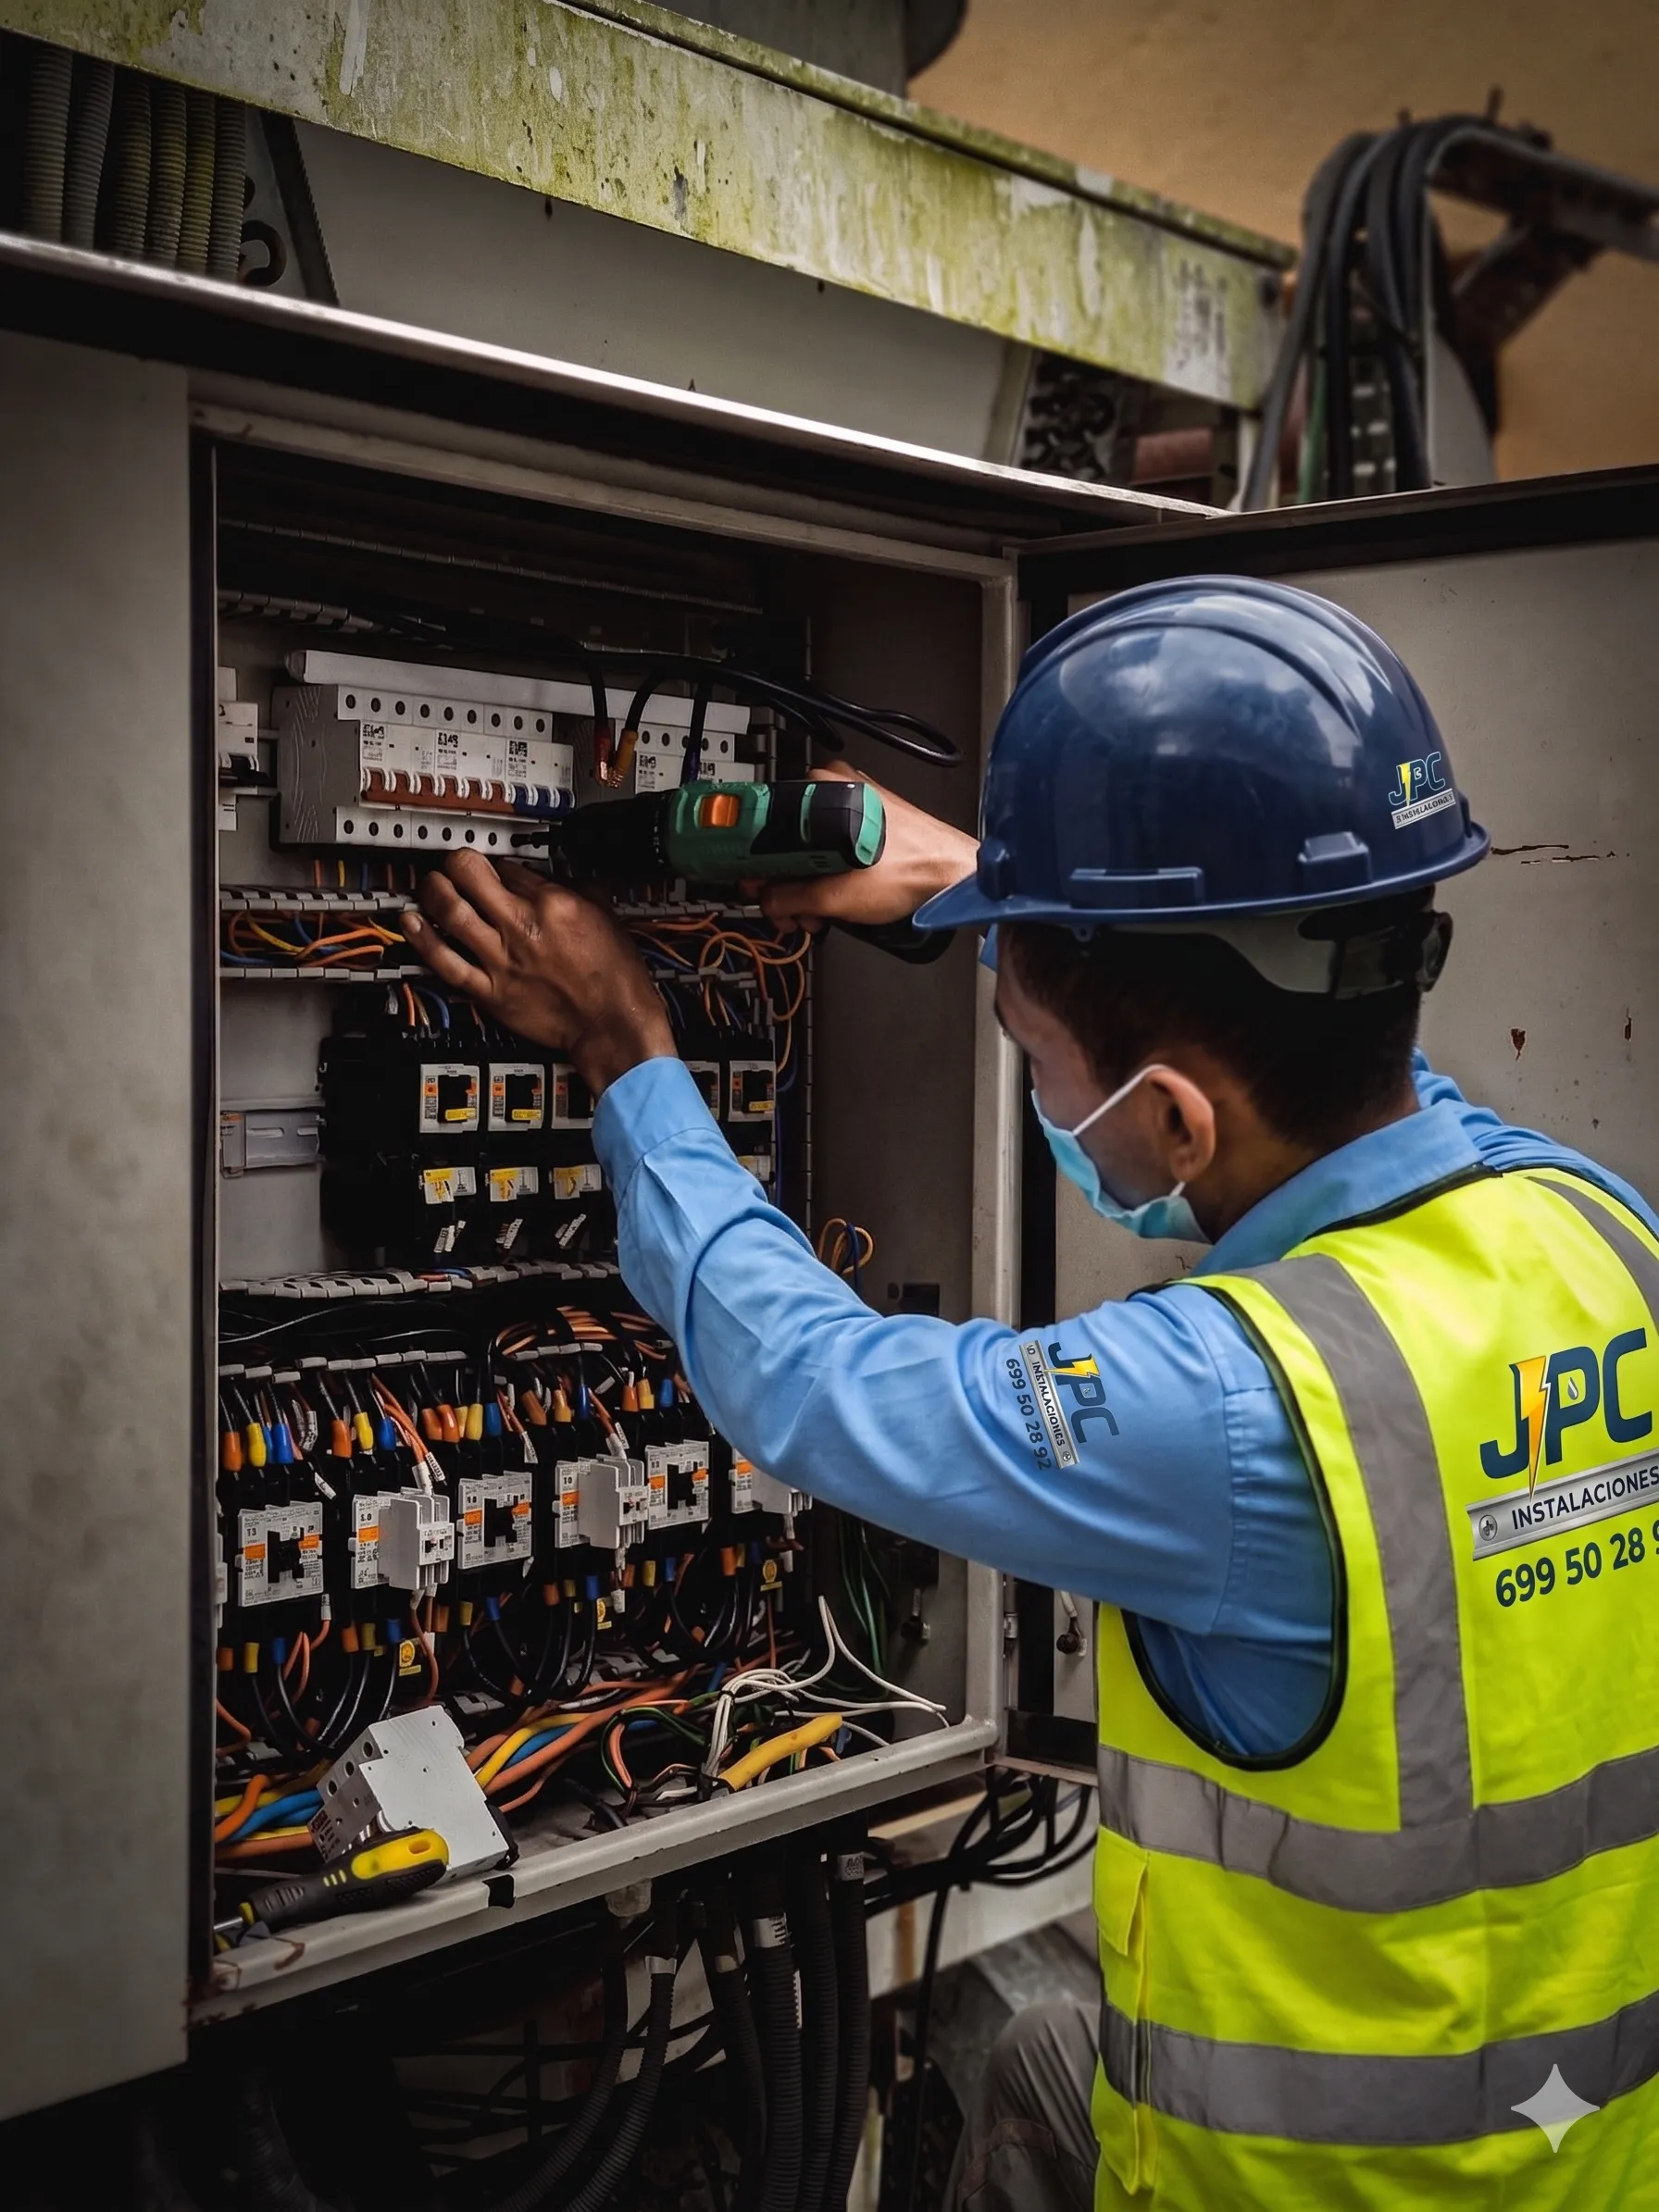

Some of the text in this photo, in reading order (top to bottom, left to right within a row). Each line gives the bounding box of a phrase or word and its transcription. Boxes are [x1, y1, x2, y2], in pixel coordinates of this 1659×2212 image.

[1388, 751, 1446, 806] JPC
[1005, 1358, 1053, 1471] 699 50 28 92
[1048, 1342, 1120, 1444] JPC
[1478, 1327, 1653, 1479] JPC
[1511, 1465, 1659, 1530] INSTALACIONES
[1495, 1557, 1556, 1608] 699
[1565, 1542, 1603, 1585] 50
[1609, 1527, 1646, 1571] 28
